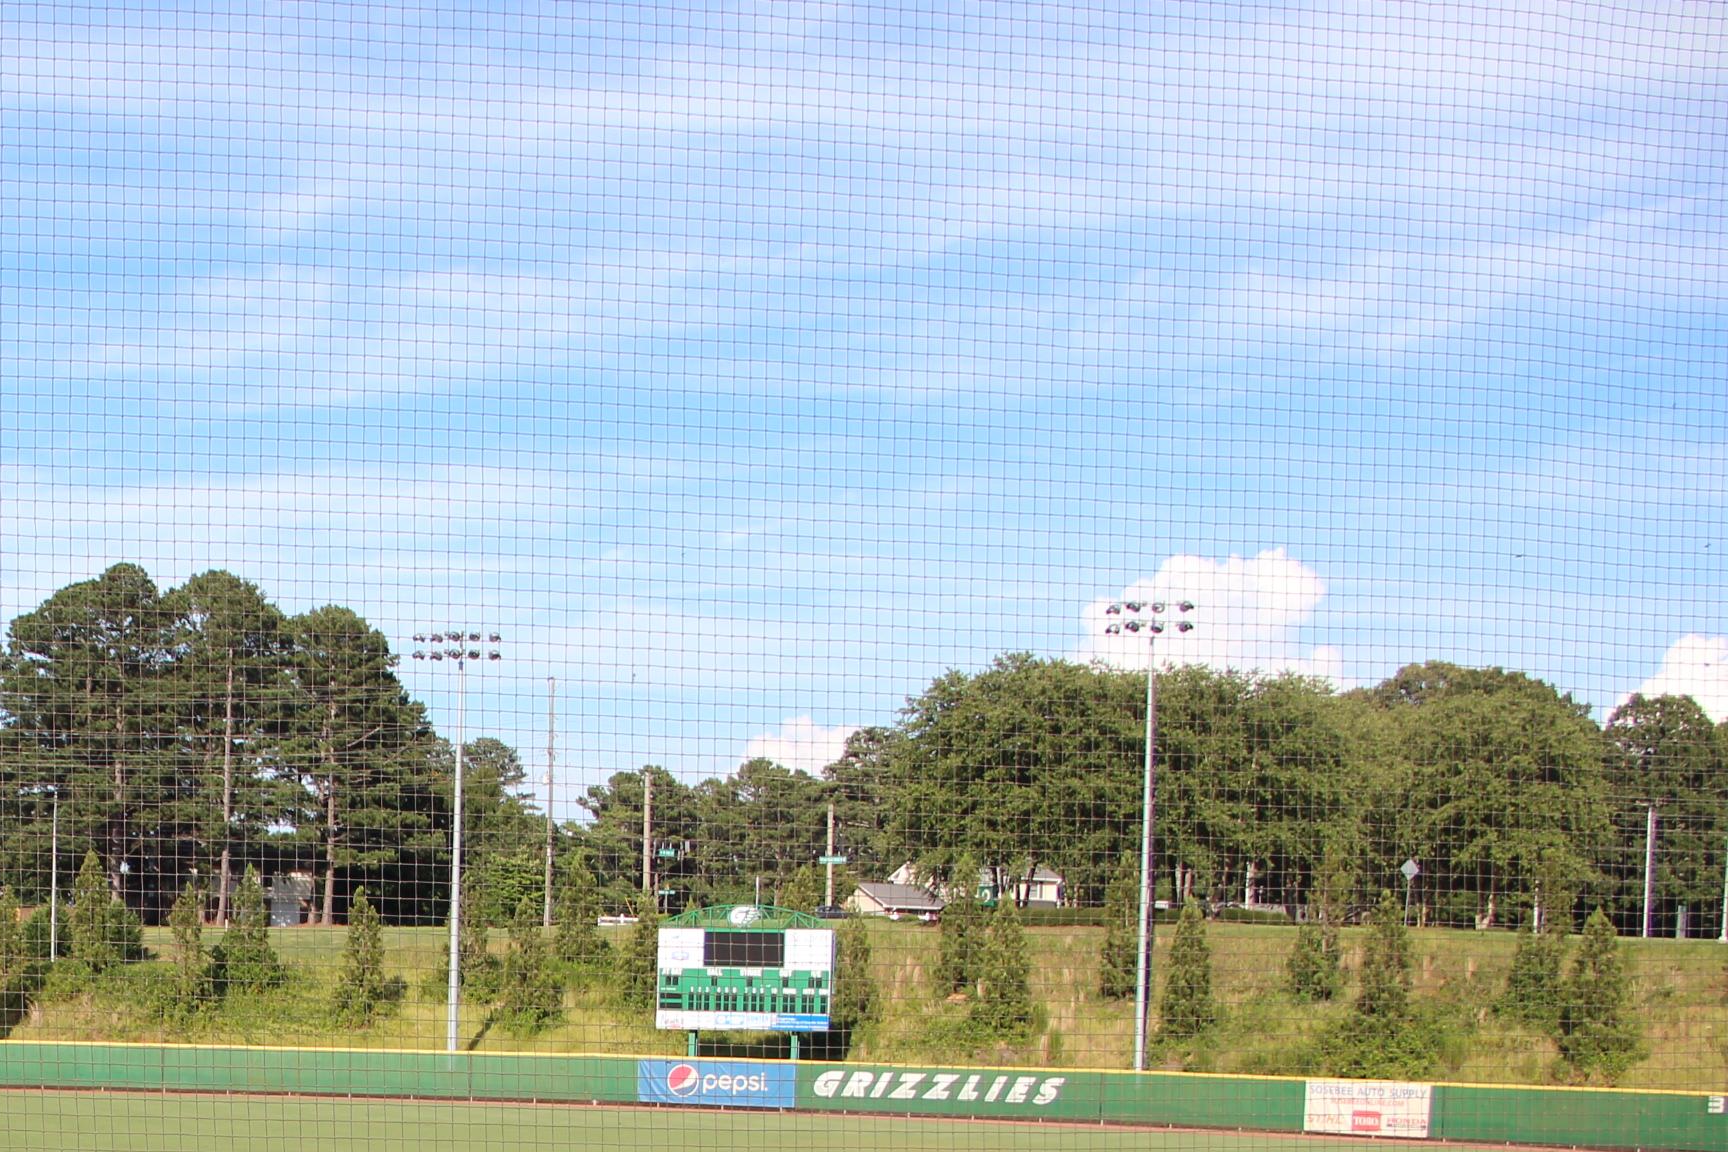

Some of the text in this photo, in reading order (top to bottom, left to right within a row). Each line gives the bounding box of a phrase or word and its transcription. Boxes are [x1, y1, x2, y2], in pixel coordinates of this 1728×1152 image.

[813, 1070, 1065, 1105] GRIZZLIES
[1310, 1085, 1427, 1099] SOSEBEE AUTO SUPPLY
[1354, 1116, 1379, 1126] TORO
